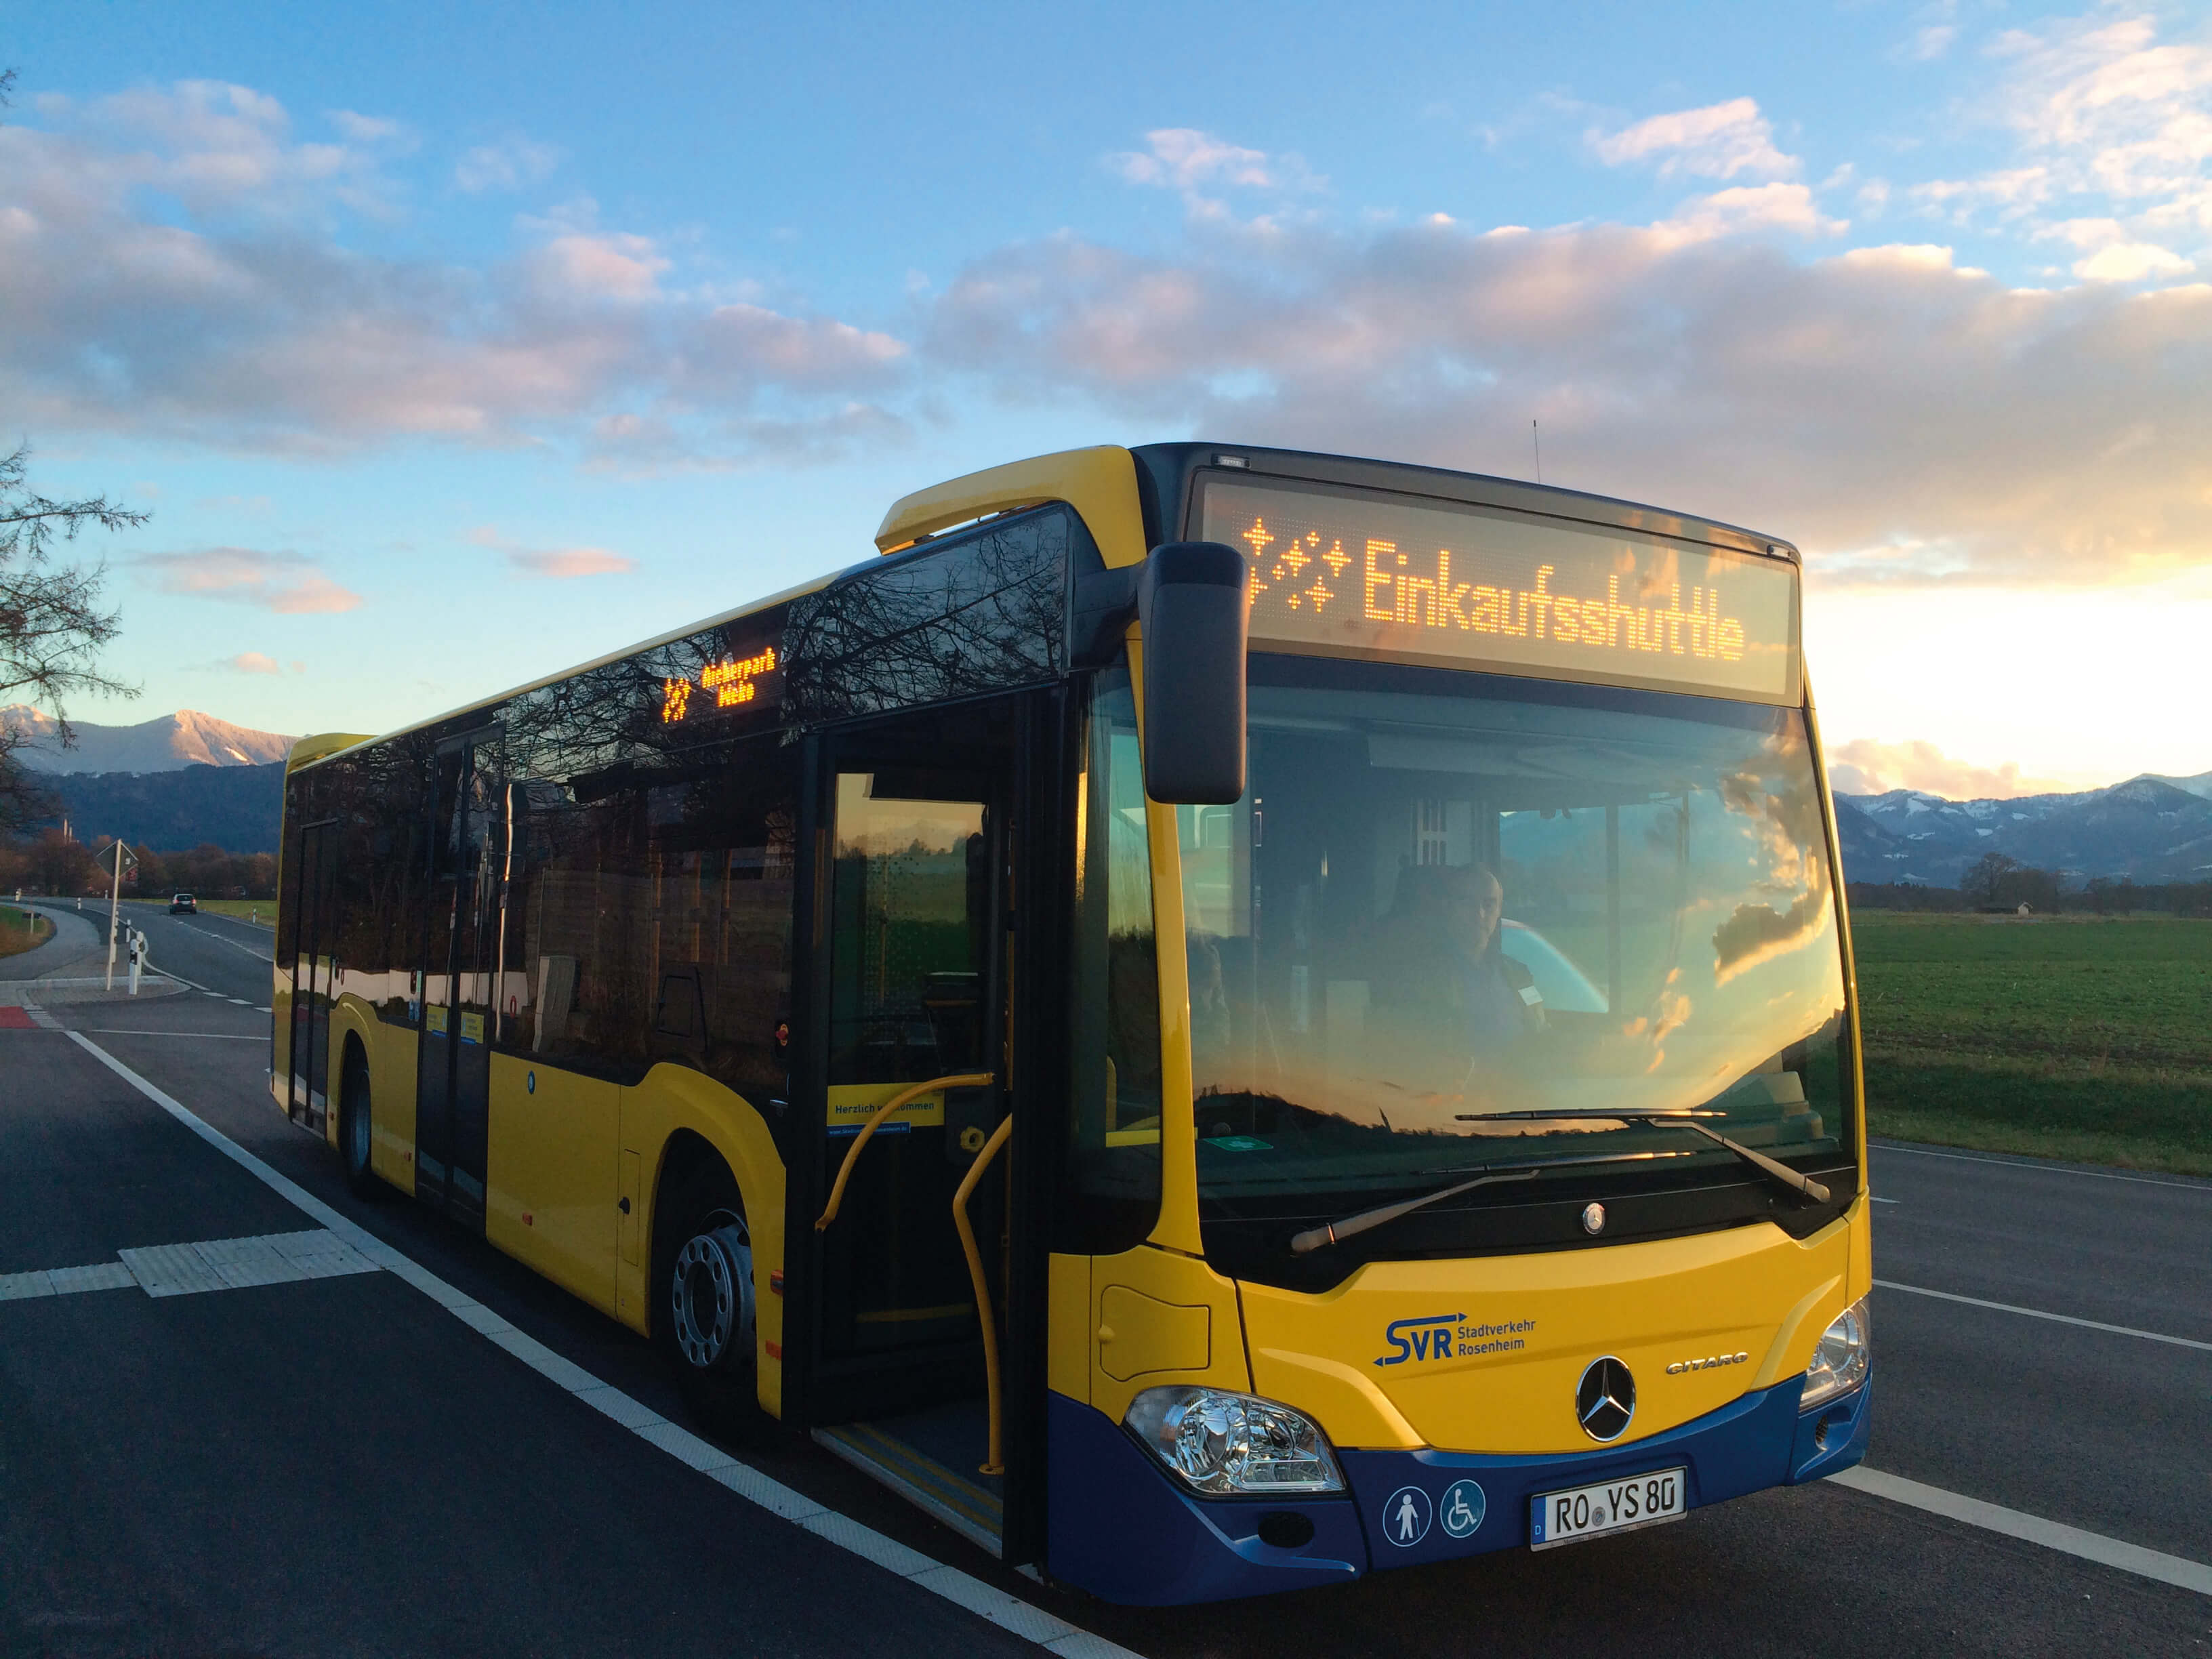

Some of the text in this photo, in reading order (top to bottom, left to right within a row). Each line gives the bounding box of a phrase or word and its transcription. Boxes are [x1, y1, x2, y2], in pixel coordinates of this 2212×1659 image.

[1364, 539, 1746, 661] Einkaufsshuttle
[835, 1103, 875, 1114] Herzlich
[1385, 1314, 1457, 1365] SVR
[1458, 1319, 1536, 1339] Stadtverkehr
[1458, 1338, 1525, 1355] Rosenheim
[1666, 1351, 1748, 1374] CITARO
[1557, 1477, 1675, 1534] RO YS 80
[1535, 1525, 1541, 1535] D
